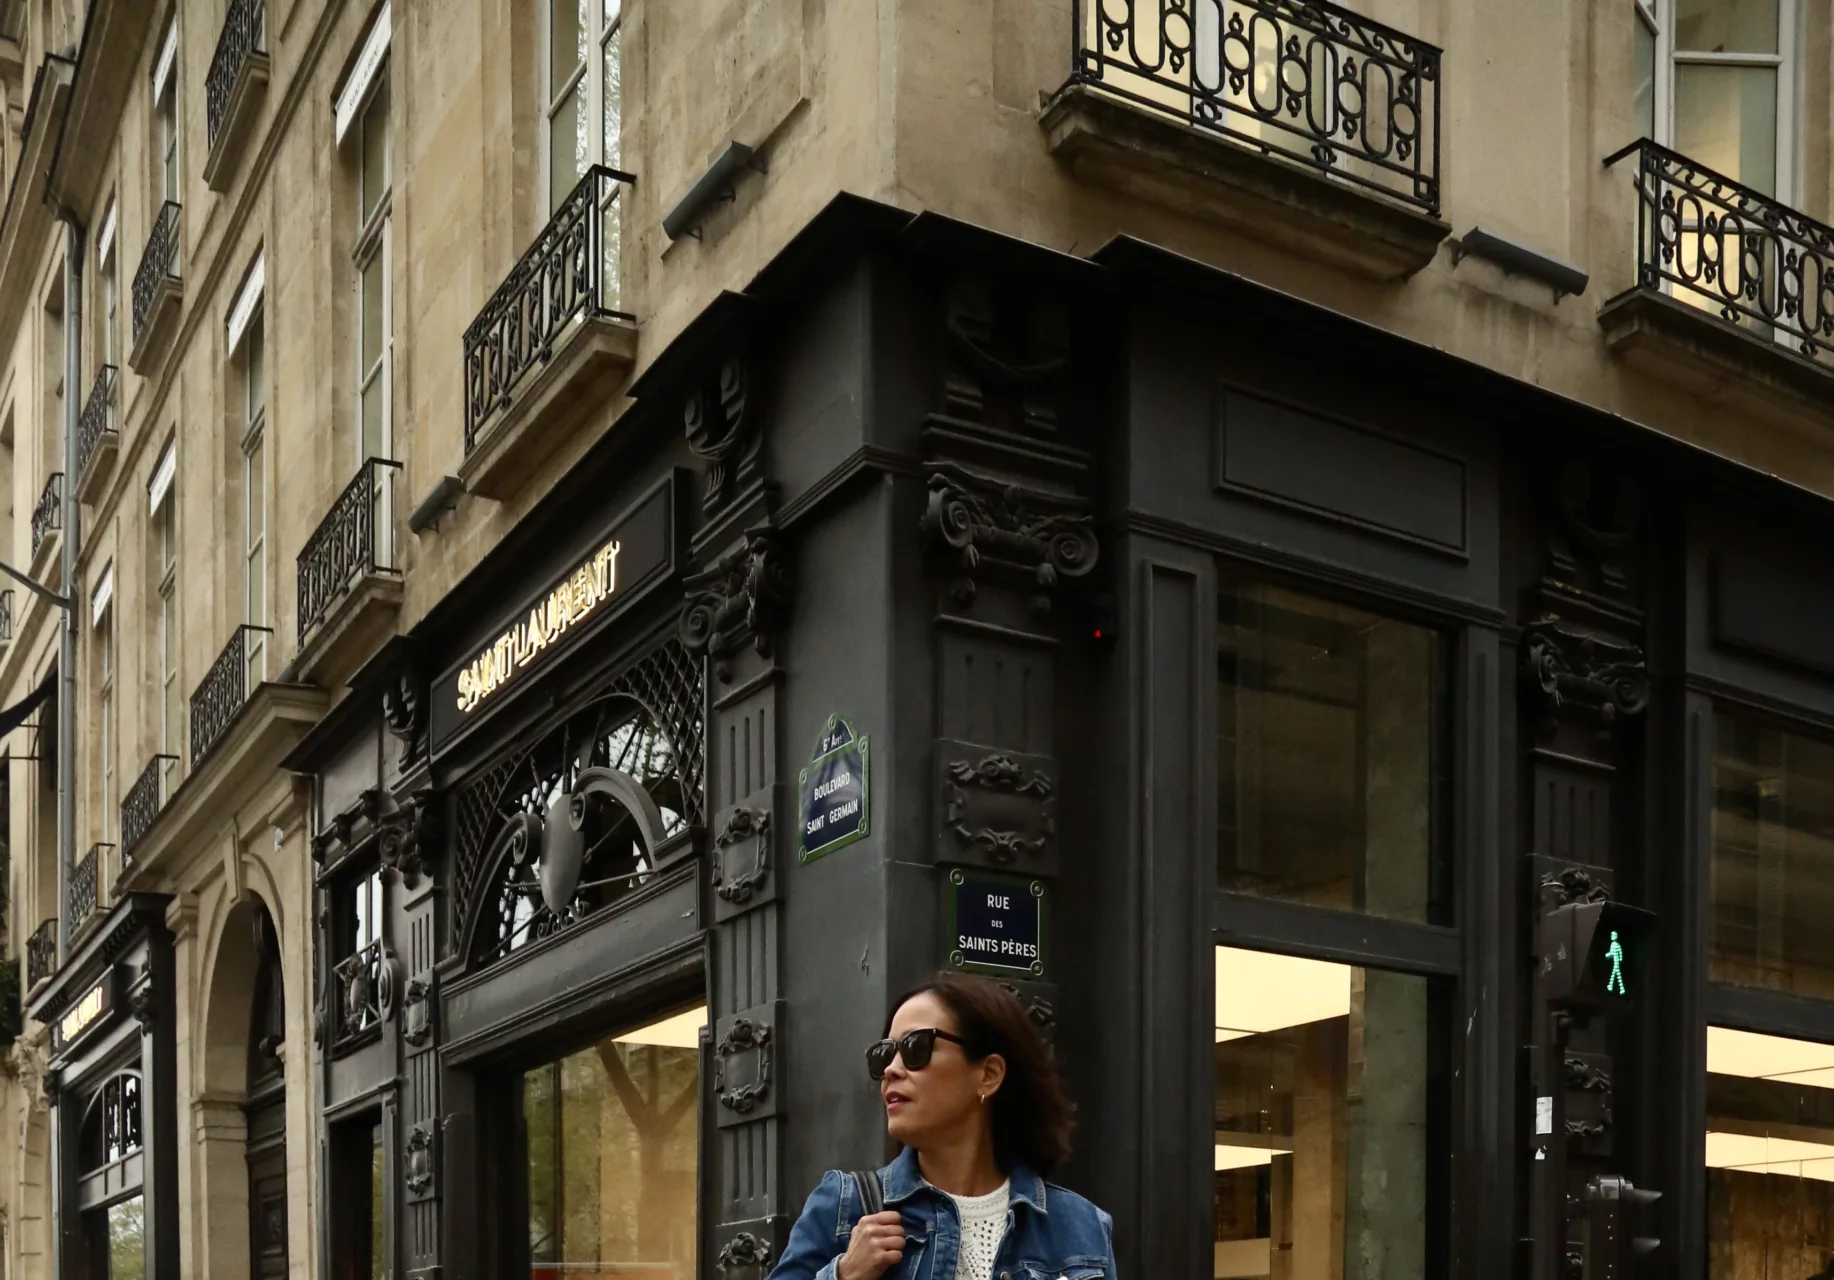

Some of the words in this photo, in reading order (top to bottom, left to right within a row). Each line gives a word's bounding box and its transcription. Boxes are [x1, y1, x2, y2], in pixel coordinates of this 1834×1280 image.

[457, 631, 516, 713] SAINT
[514, 540, 621, 668] LAURENT
[814, 772, 851, 801] BOULEVARD
[807, 815, 825, 835] SAINT
[829, 799, 858, 824] GERMAIN
[987, 894, 1010, 910] RUE
[991, 919, 1004, 928] DES
[959, 935, 999, 953] SAINTS
[1001, 939, 1037, 958] PÈRES
